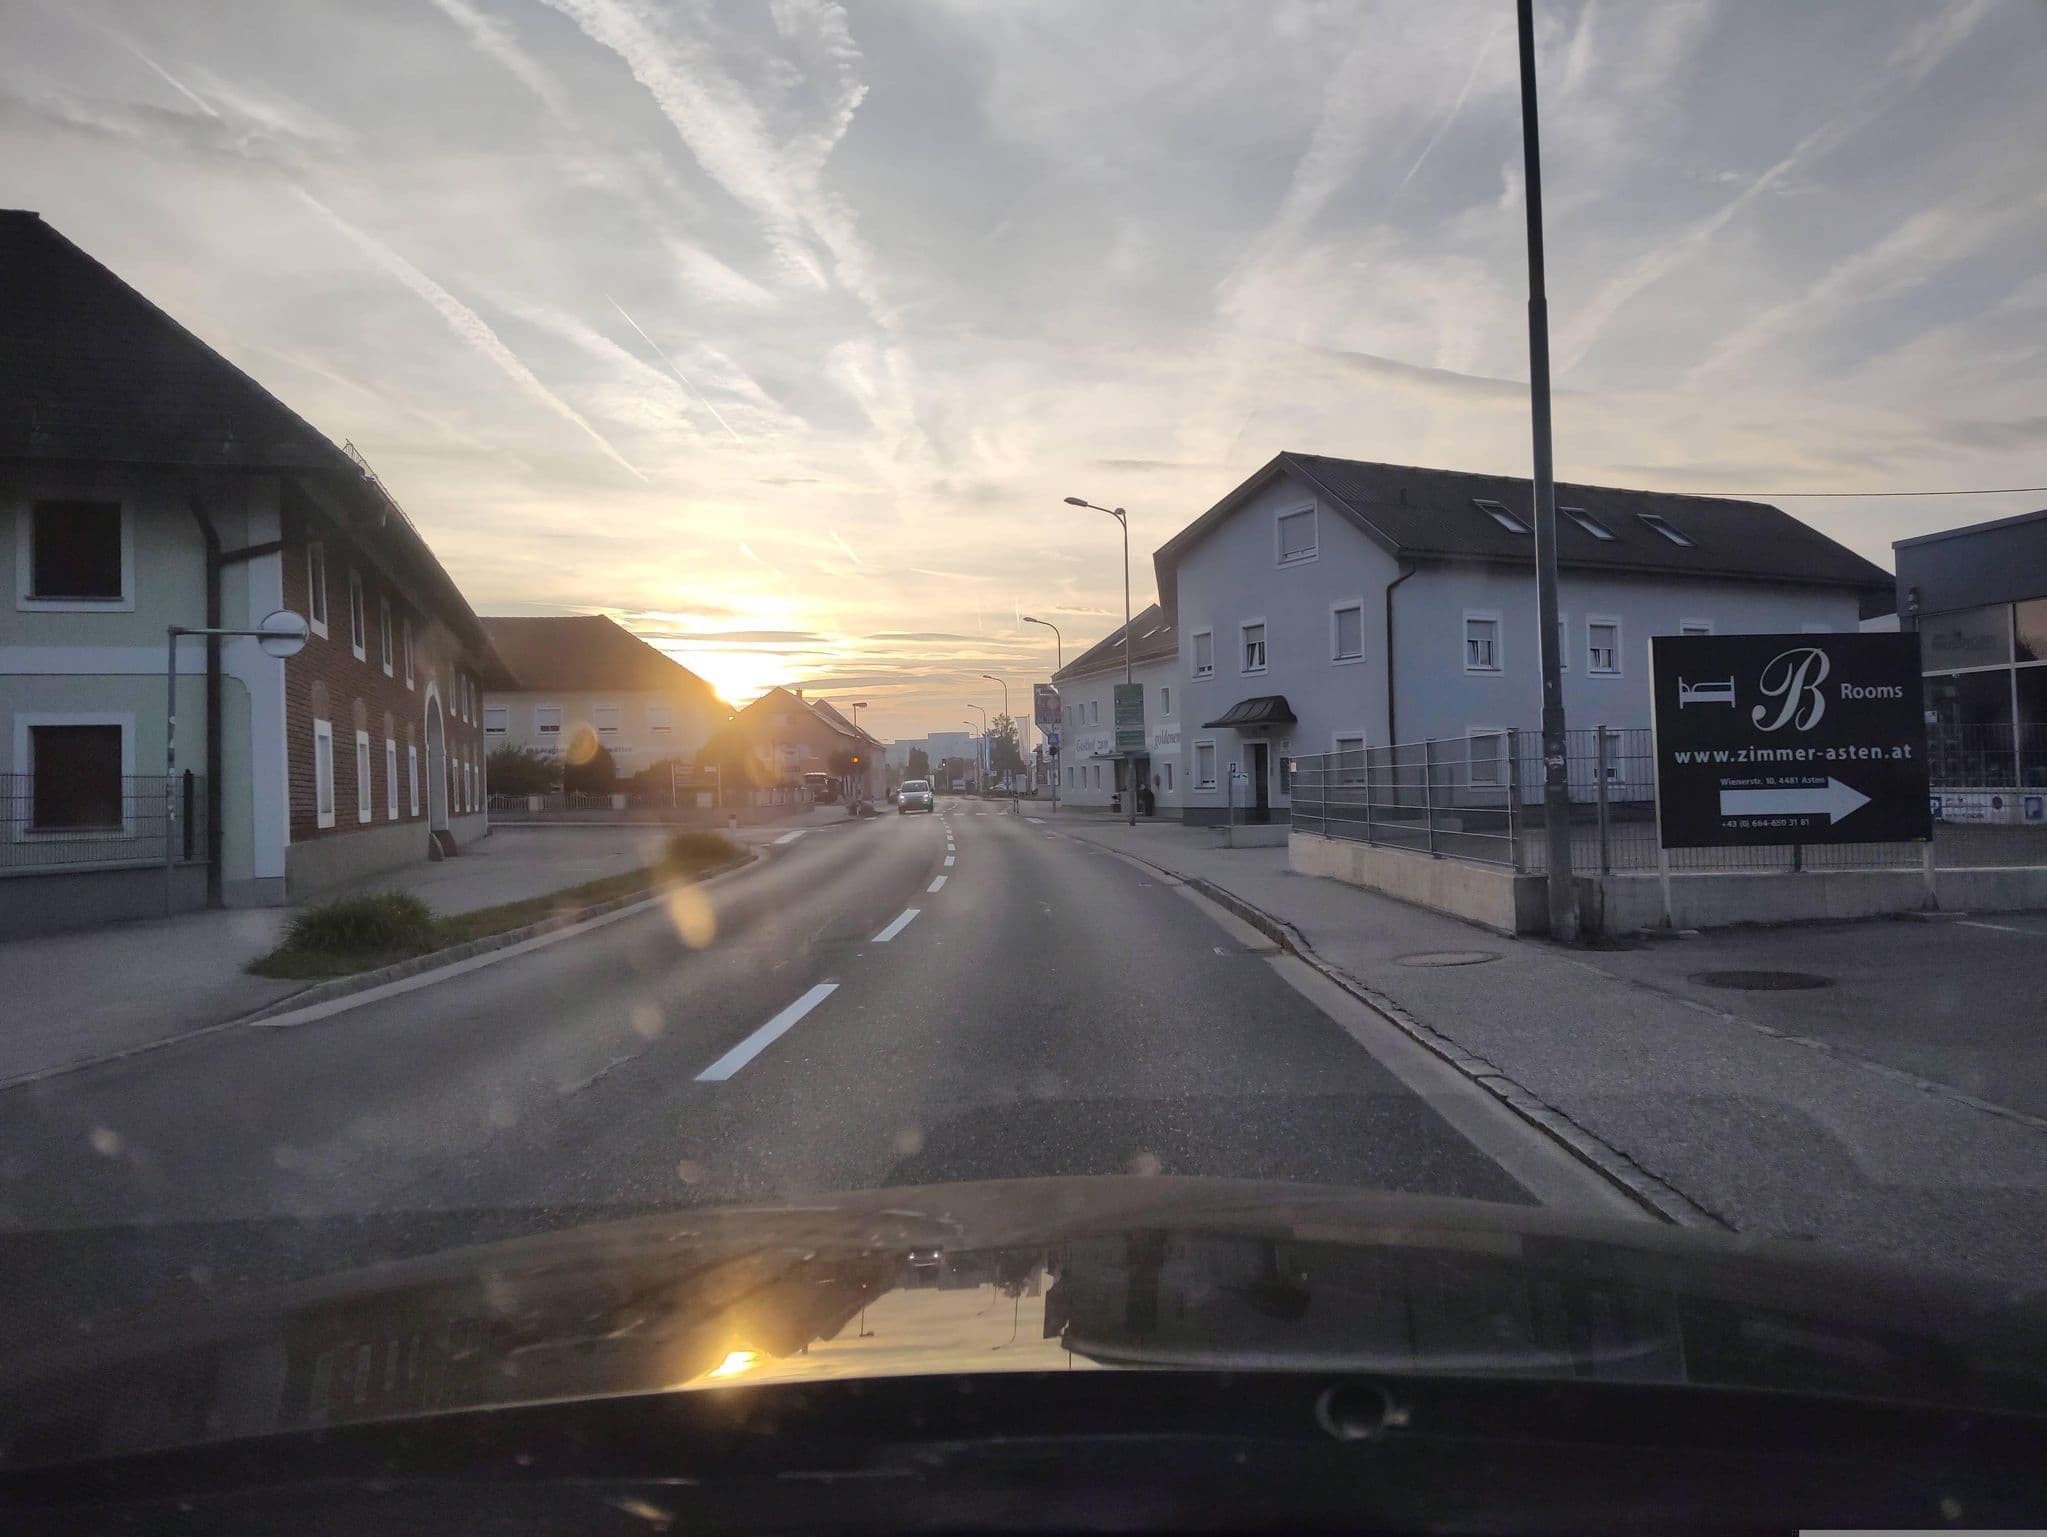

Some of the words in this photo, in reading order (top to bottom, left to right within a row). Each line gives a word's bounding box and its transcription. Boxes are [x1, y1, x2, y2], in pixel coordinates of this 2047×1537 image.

[1751, 647, 1830, 732] B
[1841, 683, 1903, 700] Rooms
[1674, 743, 1912, 764] www.zimmer-asten.at
[1801, 776, 1825, 784] Asten
